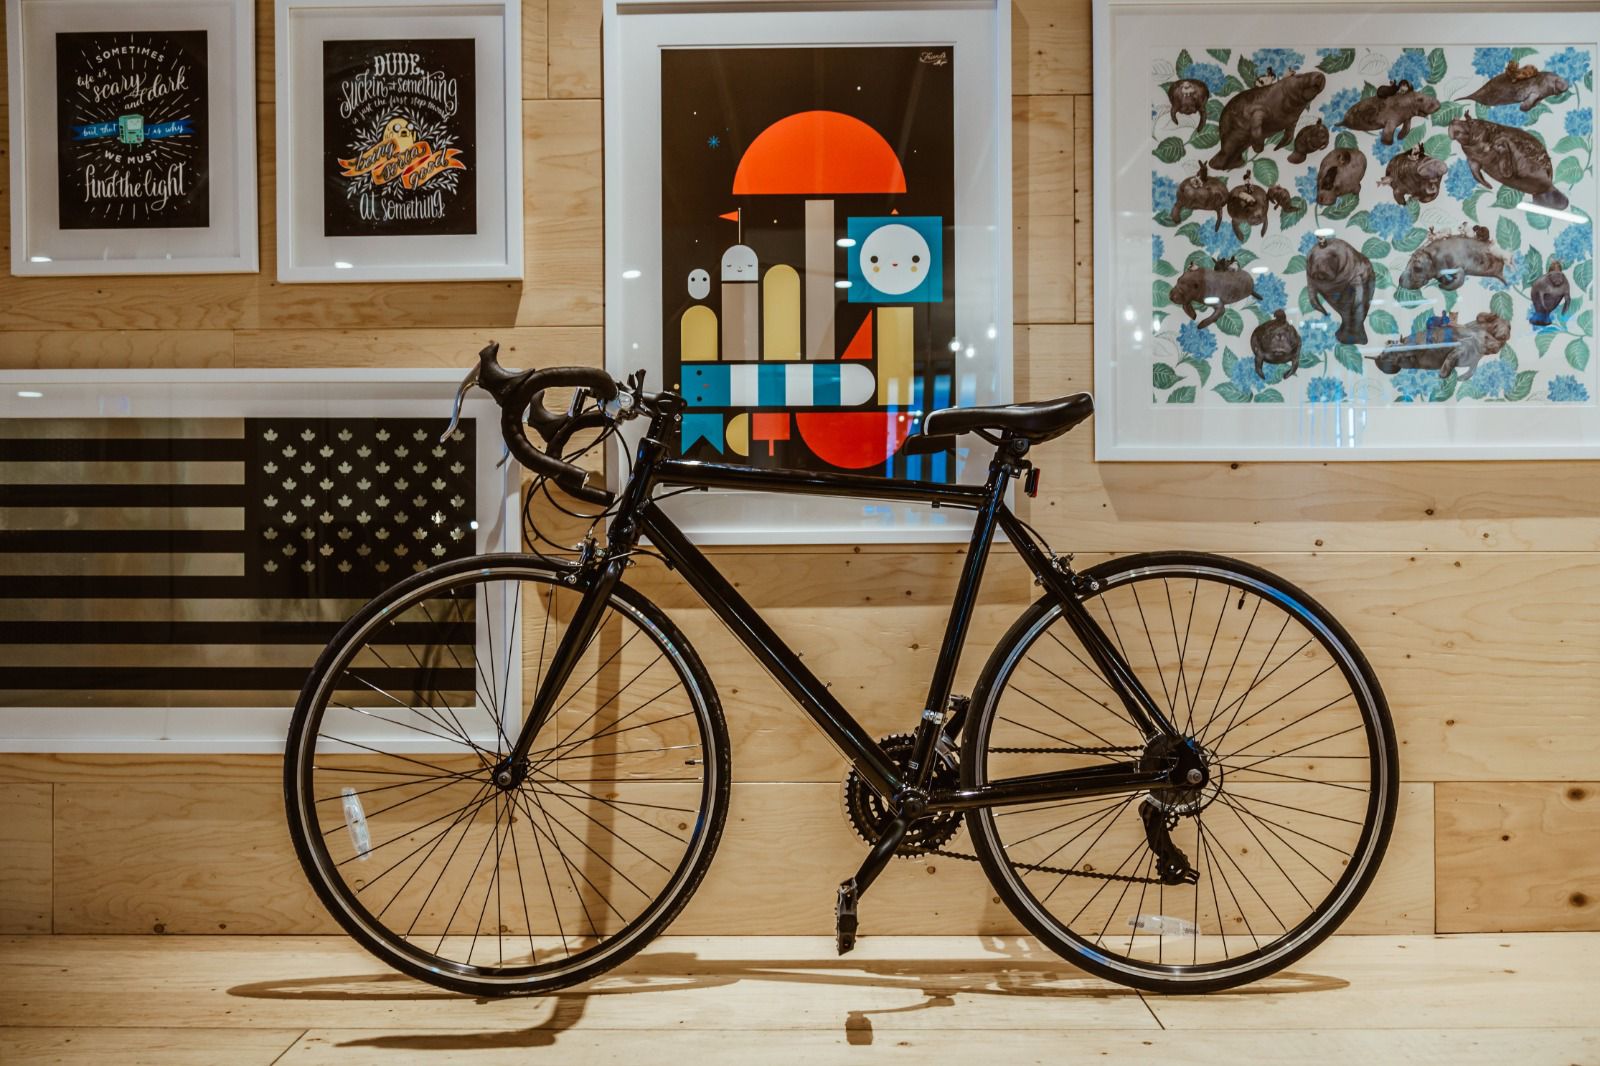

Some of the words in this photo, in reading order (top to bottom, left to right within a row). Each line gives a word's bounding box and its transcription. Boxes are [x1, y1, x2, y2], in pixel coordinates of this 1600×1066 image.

[96, 46, 165, 63] SOMETIMES
[77, 73, 95, 90] life
[93, 72, 147, 103] scary
[147, 65, 189, 102] dark
[397, 70, 458, 117] something
[374, 97, 386, 107] the
[389, 95, 408, 108] first
[410, 96, 427, 108] step
[104, 150, 123, 163] WE
[127, 149, 158, 164] MUST
[356, 142, 395, 170] being
[409, 145, 449, 190] good
[84, 164, 119, 203] find
[116, 170, 143, 198] the
[144, 160, 187, 211] light
